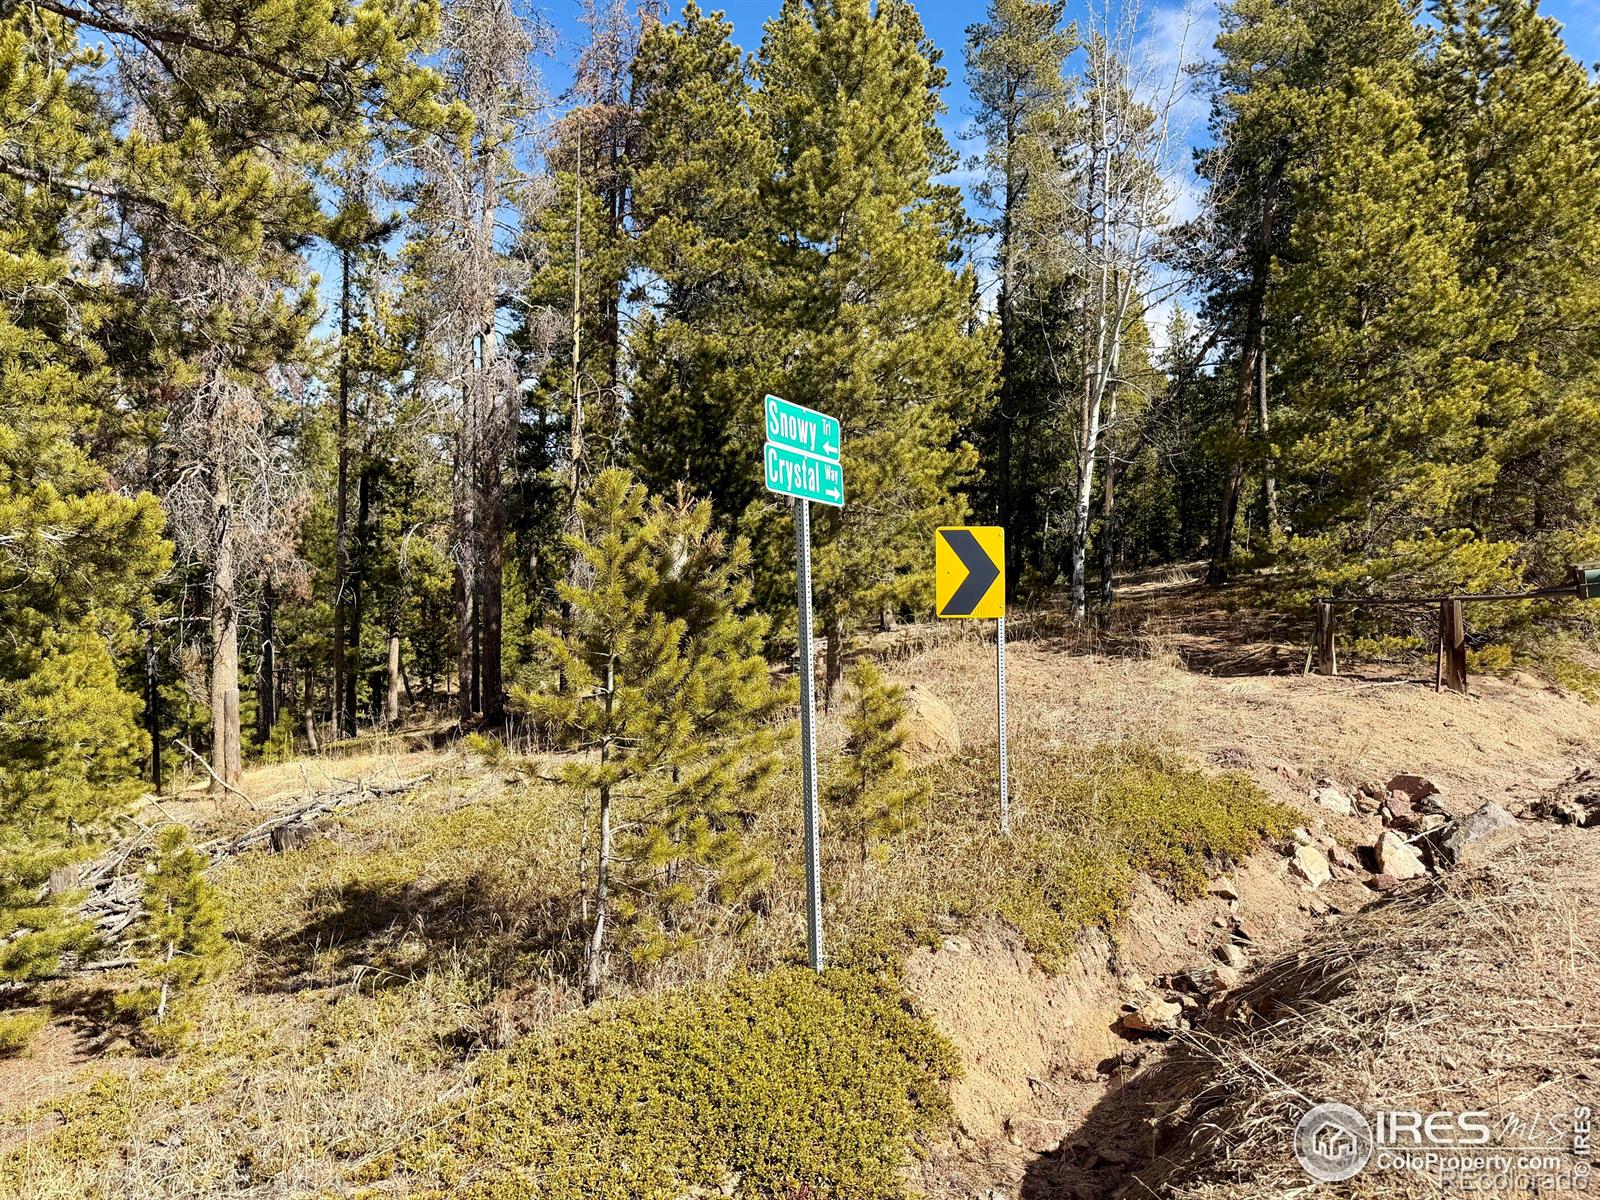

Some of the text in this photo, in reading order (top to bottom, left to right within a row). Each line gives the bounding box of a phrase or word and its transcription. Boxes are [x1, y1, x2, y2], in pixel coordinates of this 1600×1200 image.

[769, 400, 816, 451] Snowy
[768, 448, 838, 492] Crystal Way
